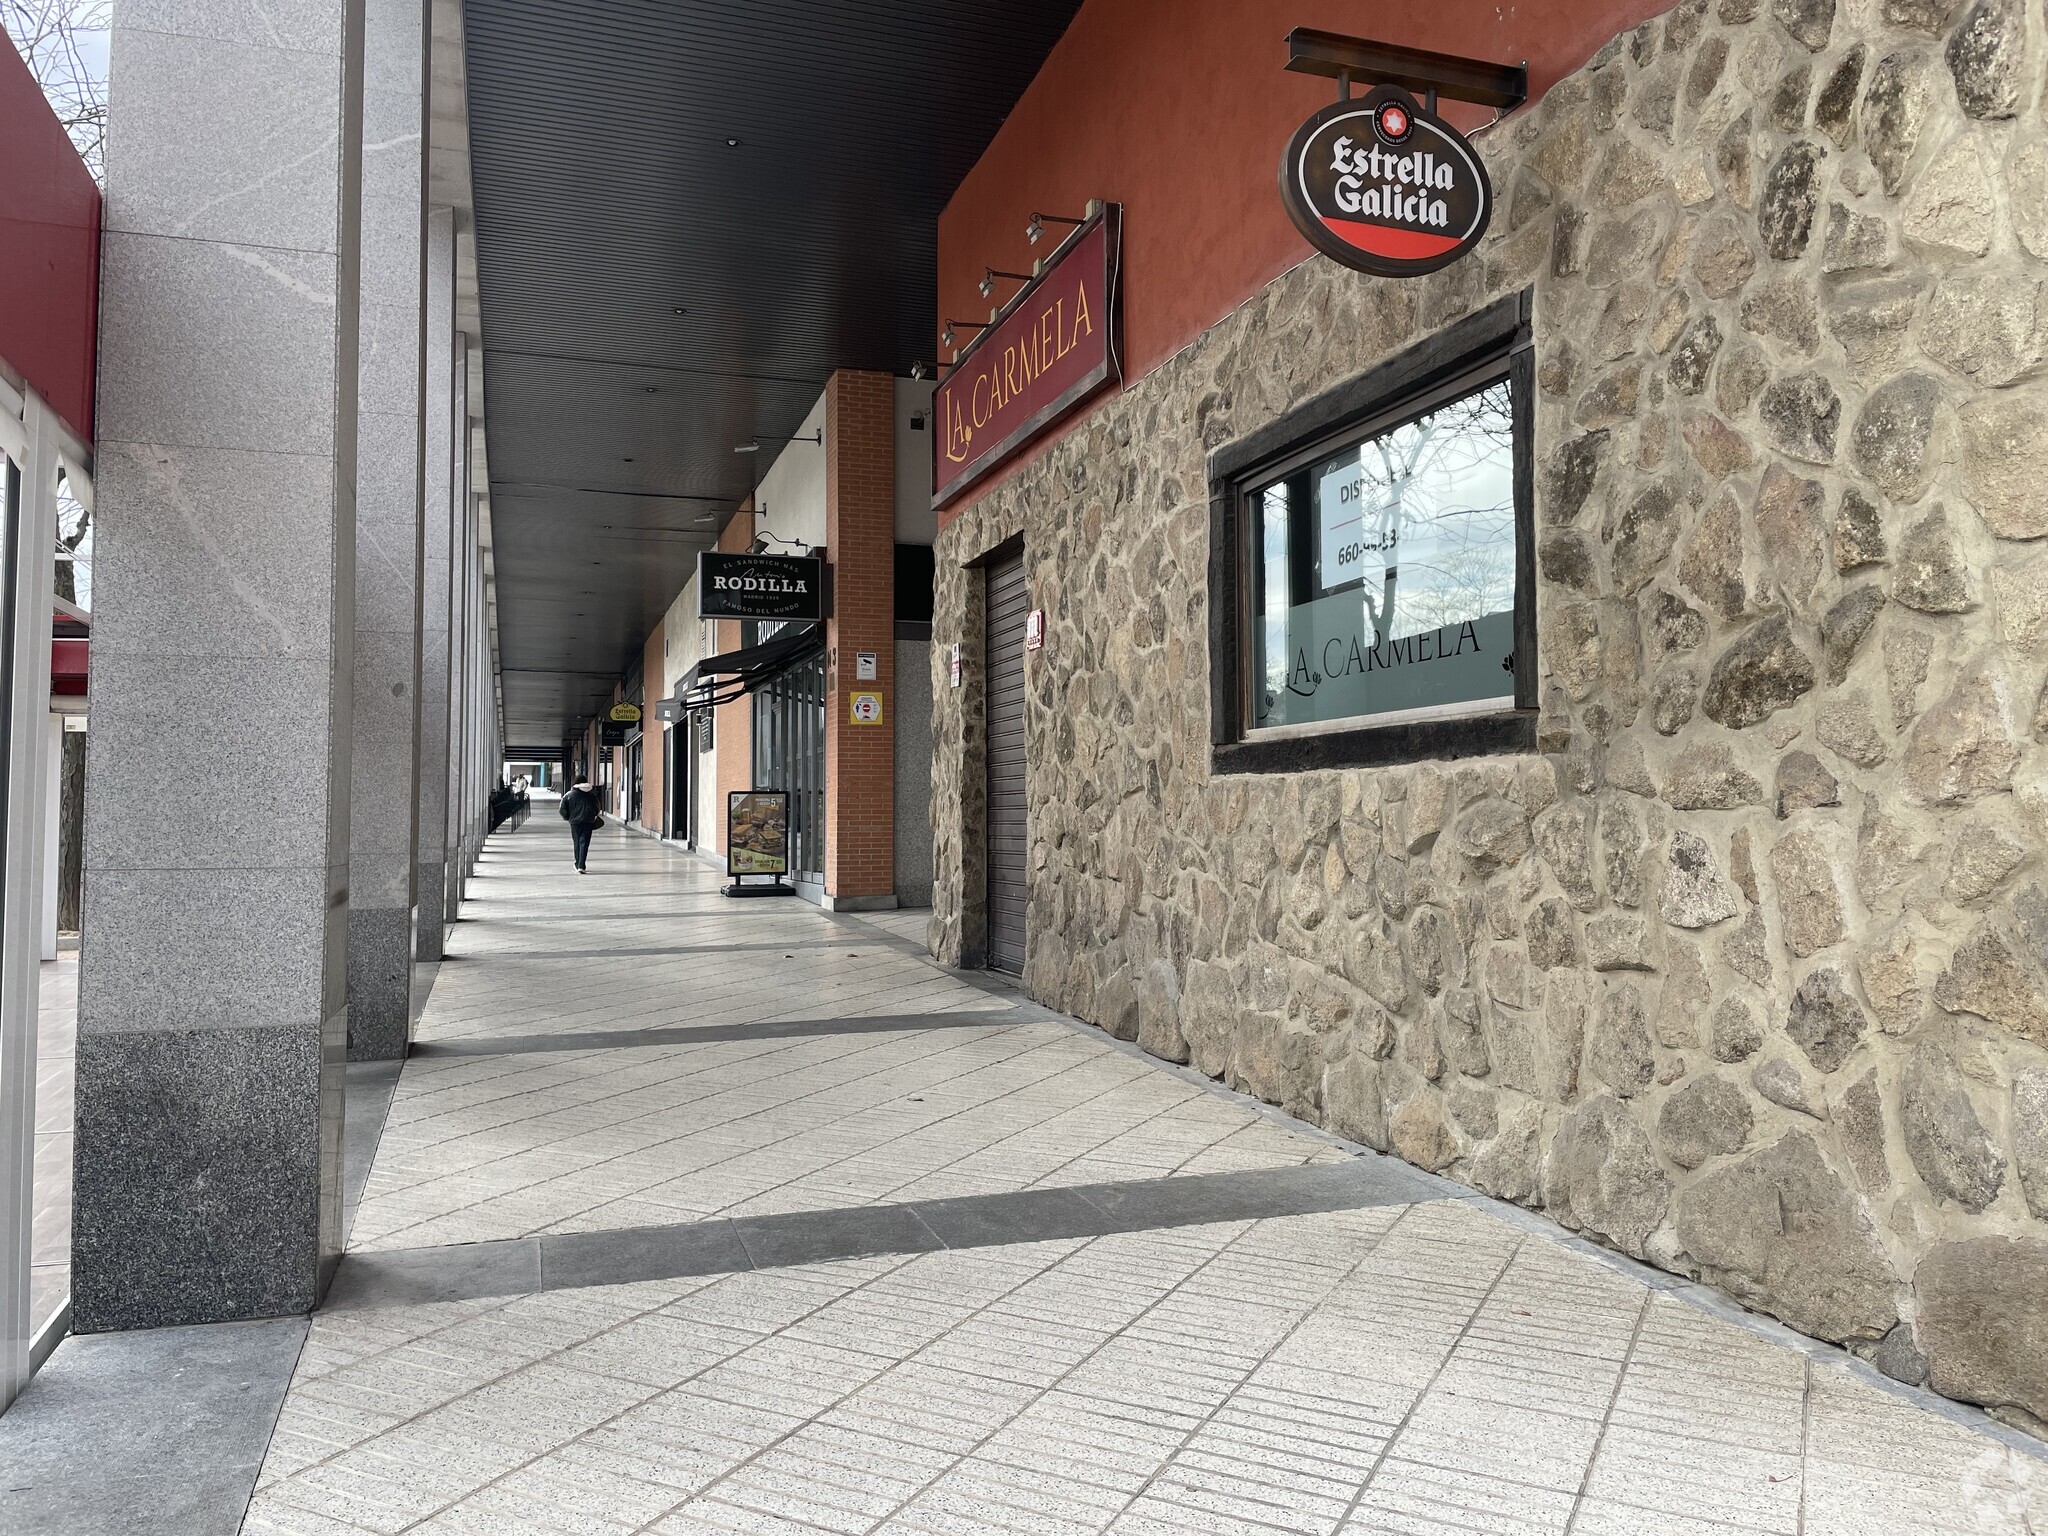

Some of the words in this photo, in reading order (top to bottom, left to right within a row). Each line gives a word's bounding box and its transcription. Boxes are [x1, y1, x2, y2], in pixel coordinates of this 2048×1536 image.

[1330, 135, 1455, 191] Estrella
[1335, 174, 1449, 228] Galicia
[945, 387, 972, 463] LA
[972, 279, 1093, 428] CARMELA
[714, 576, 807, 593] RODILLA
[723, 562, 733, 570] EL
[737, 559, 780, 567] SANDWICH
[722, 599, 753, 613] FAMOSO
[774, 602, 800, 613] MUNDO
[1323, 620, 1482, 678] CARMELA
